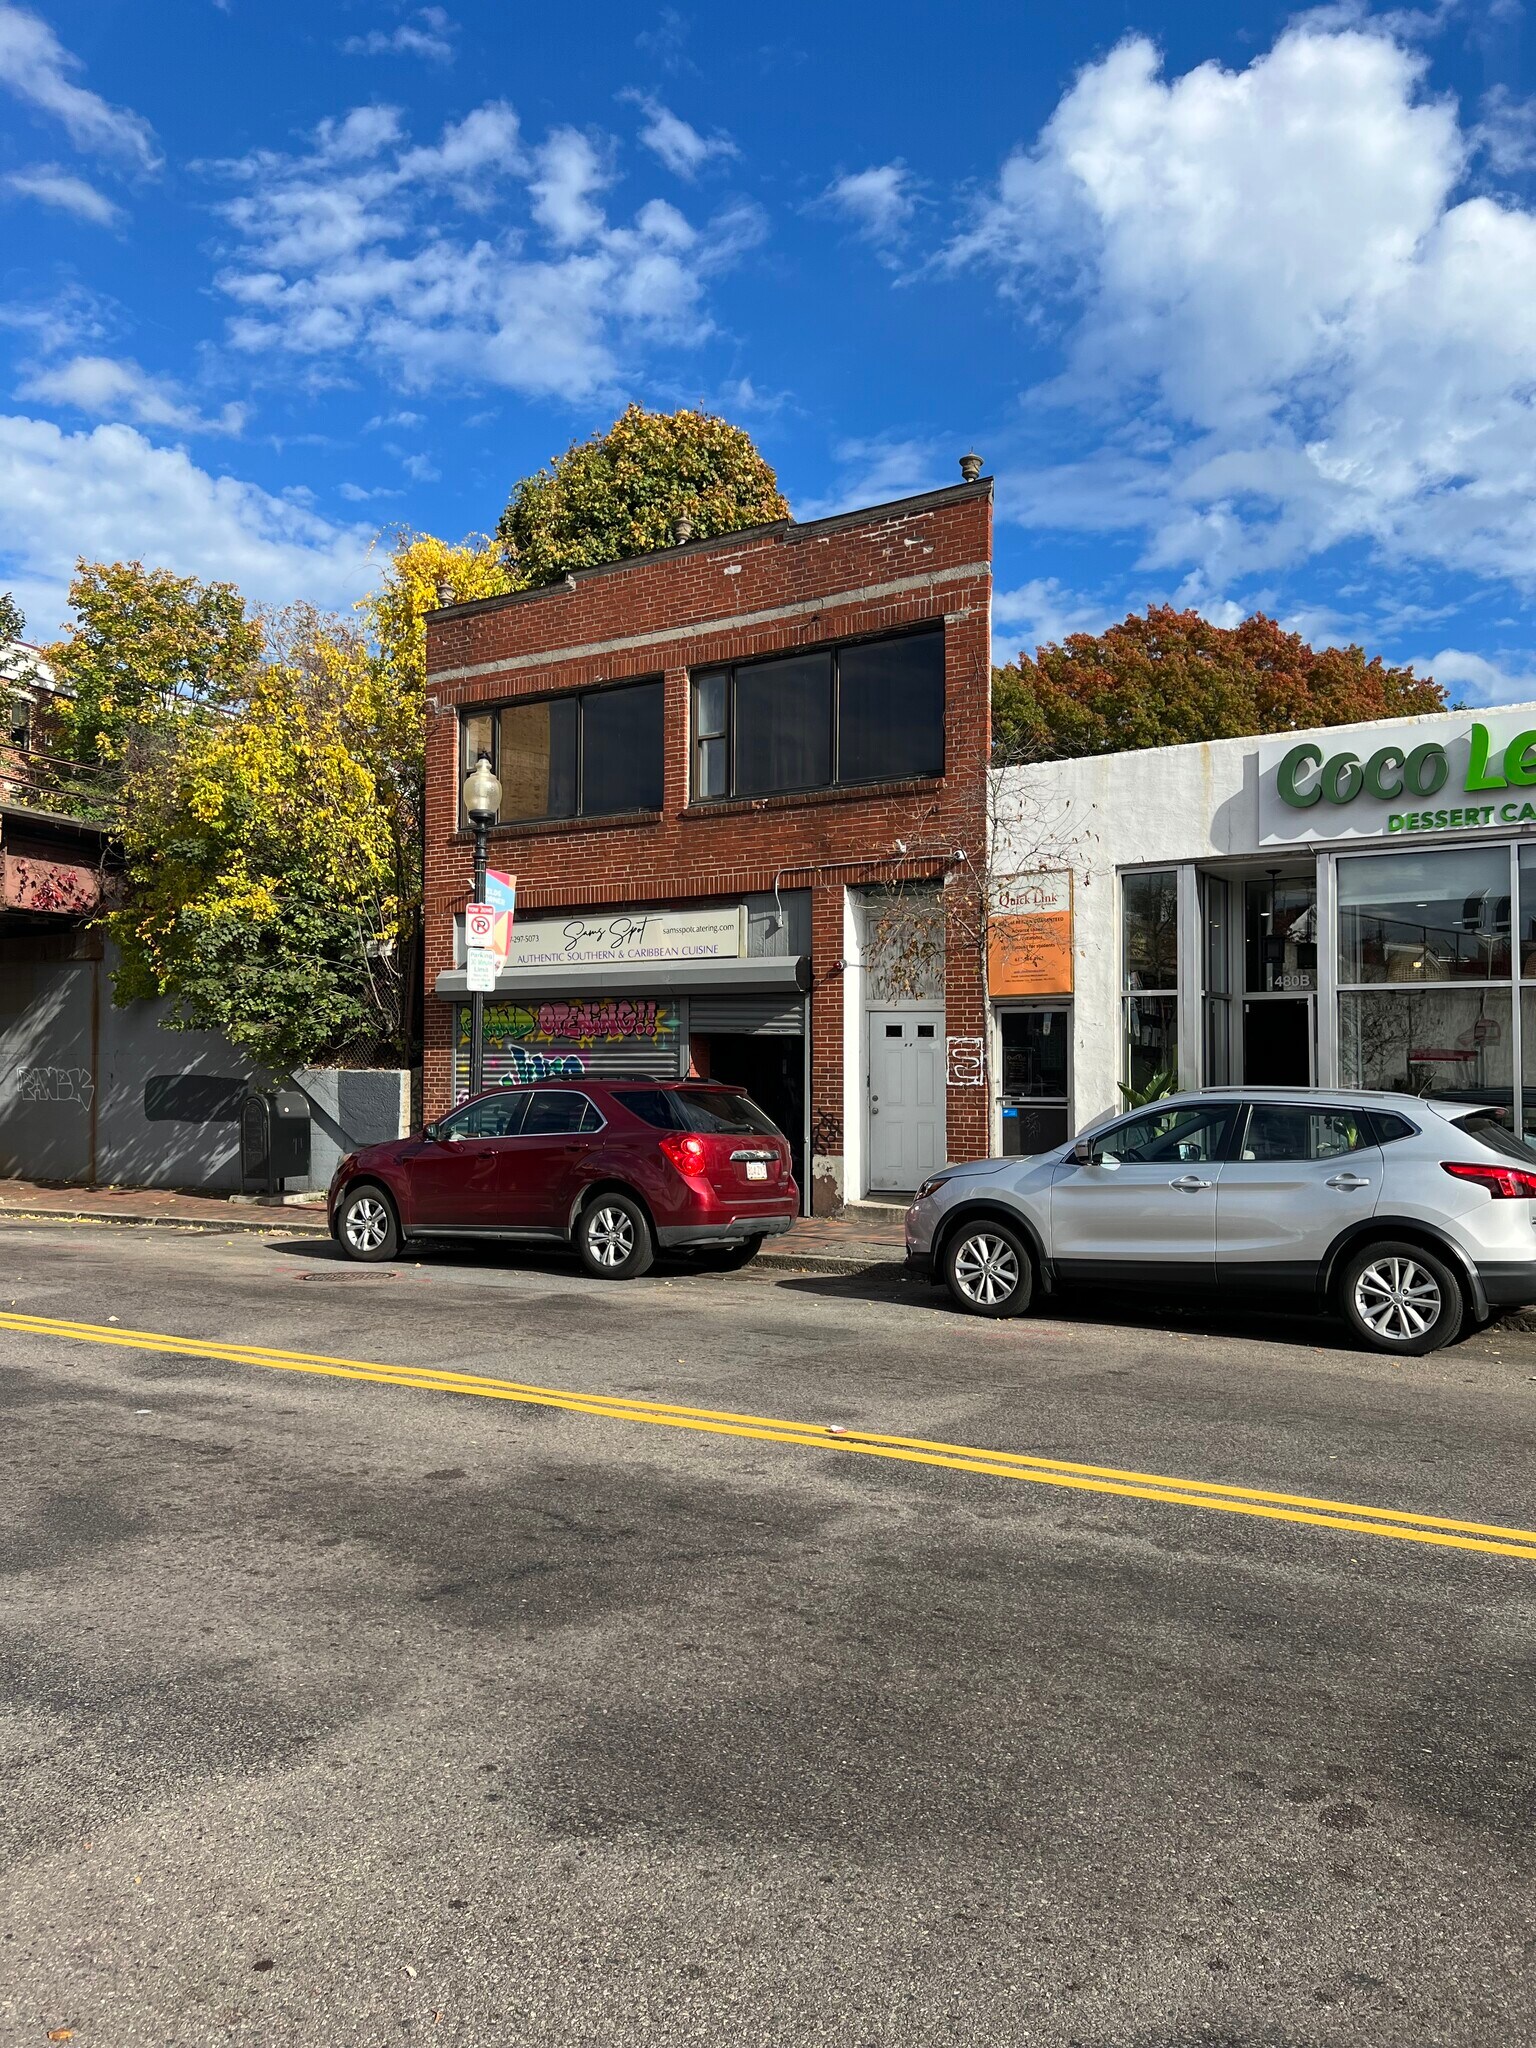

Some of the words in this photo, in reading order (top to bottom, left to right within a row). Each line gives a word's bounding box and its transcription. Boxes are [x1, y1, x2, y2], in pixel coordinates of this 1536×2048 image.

[1277, 743, 1450, 808] Coco
[1464, 723, 1536, 793] Le
[1388, 806, 1495, 832] DESSERT
[999, 892, 1030, 908] Quick
[1033, 892, 1058, 905] Link
[563, 920, 606, 952] Sams
[609, 916, 663, 949] Spot
[662, 923, 735, 935] samsspotcatering.com
[470, 951, 493, 960] Parking
[517, 952, 565, 964] AUTHENTIC
[567, 949, 616, 961] SOUTHERN
[618, 948, 625, 959] &
[627, 946, 679, 959] CARIBBEAN
[681, 943, 719, 956] CUISINE
[1267, 974, 1310, 989] 1480B
